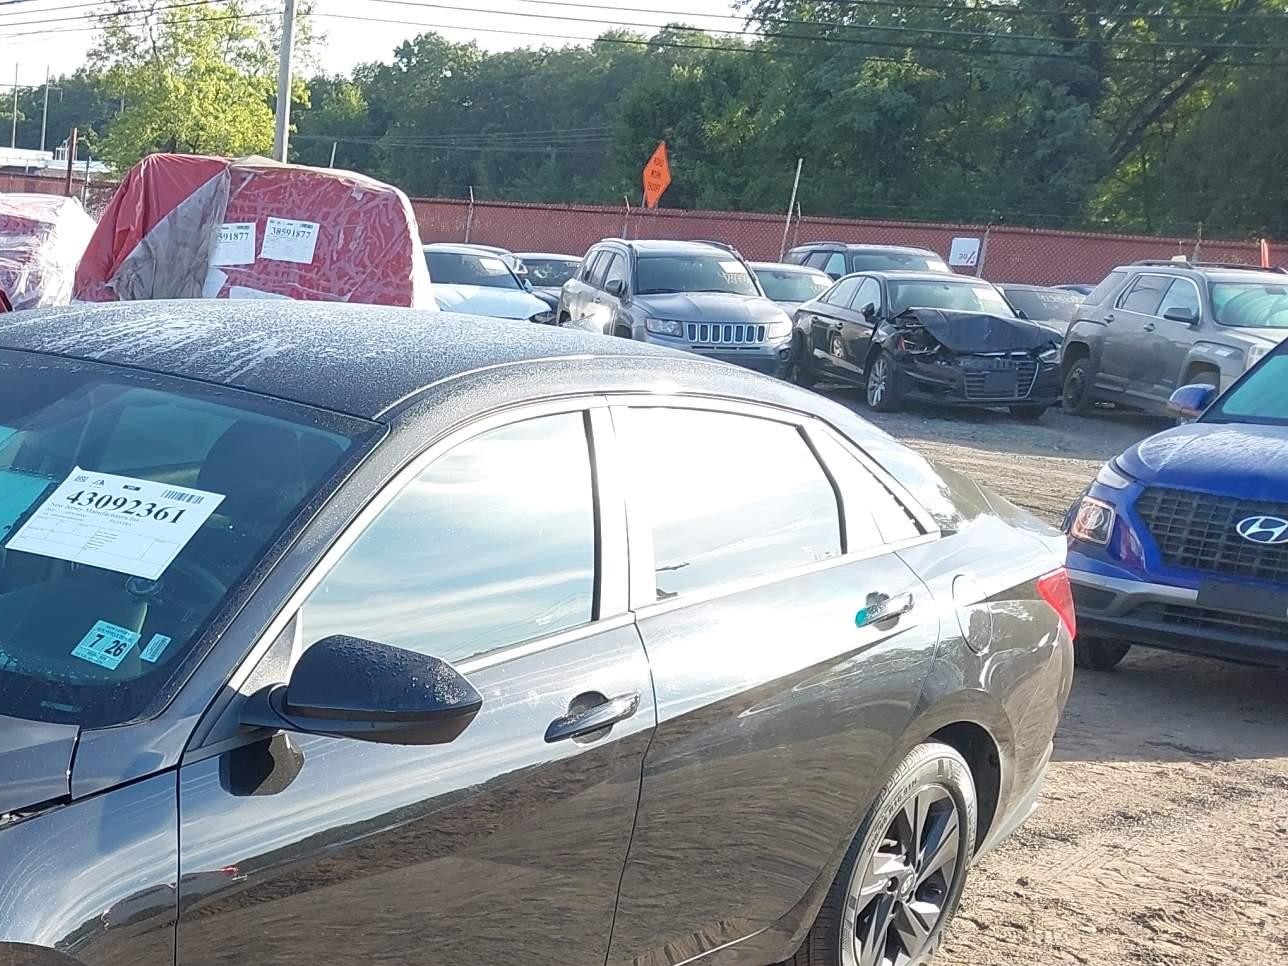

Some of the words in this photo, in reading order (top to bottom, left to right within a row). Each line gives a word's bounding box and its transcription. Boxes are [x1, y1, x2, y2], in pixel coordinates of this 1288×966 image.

[271, 226, 312, 240] 38591877
[66, 489, 187, 524] 43092361
[89, 633, 105, 648] 7
[104, 639, 127, 657] 26
